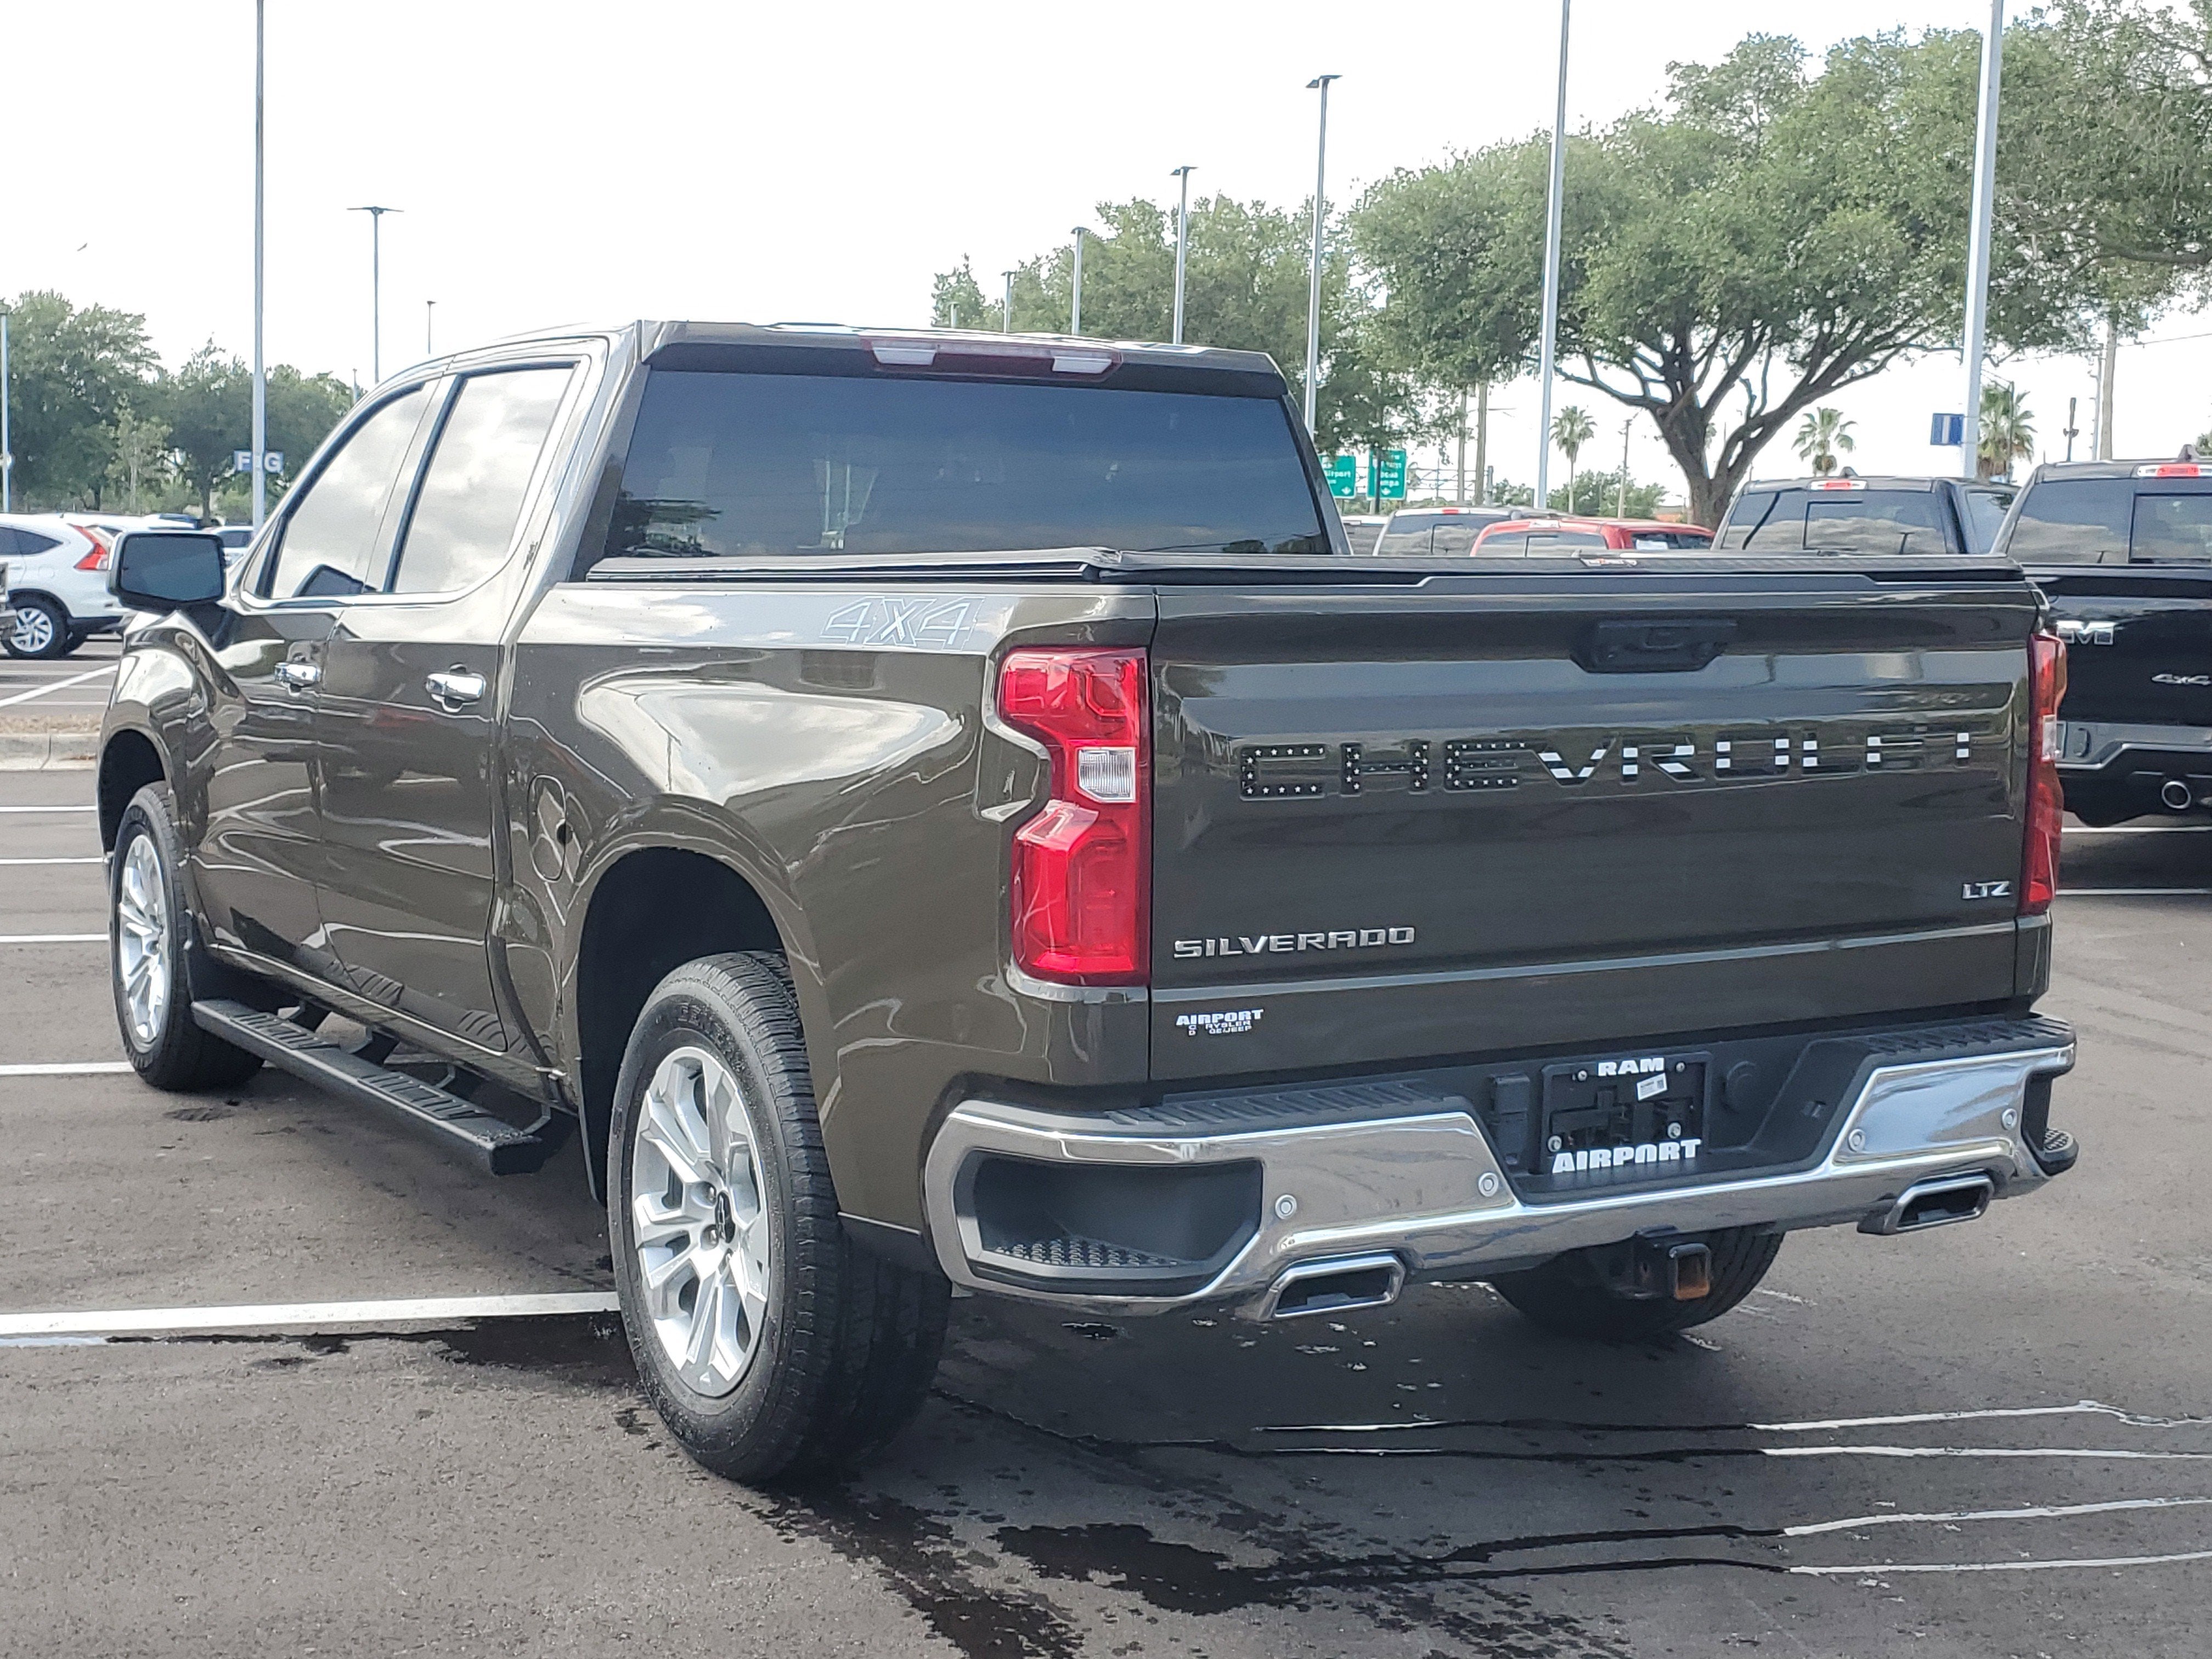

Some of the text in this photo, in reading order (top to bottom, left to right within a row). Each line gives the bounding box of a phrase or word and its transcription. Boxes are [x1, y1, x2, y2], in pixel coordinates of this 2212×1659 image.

[1961, 880, 2012, 900] LTZ
[1173, 926, 1416, 958] SILVERADO
[1175, 1008, 1264, 1026] AIRPORT
[1598, 1057, 1665, 1077] RAM
[1551, 1138, 1702, 1174] AIRPORT
